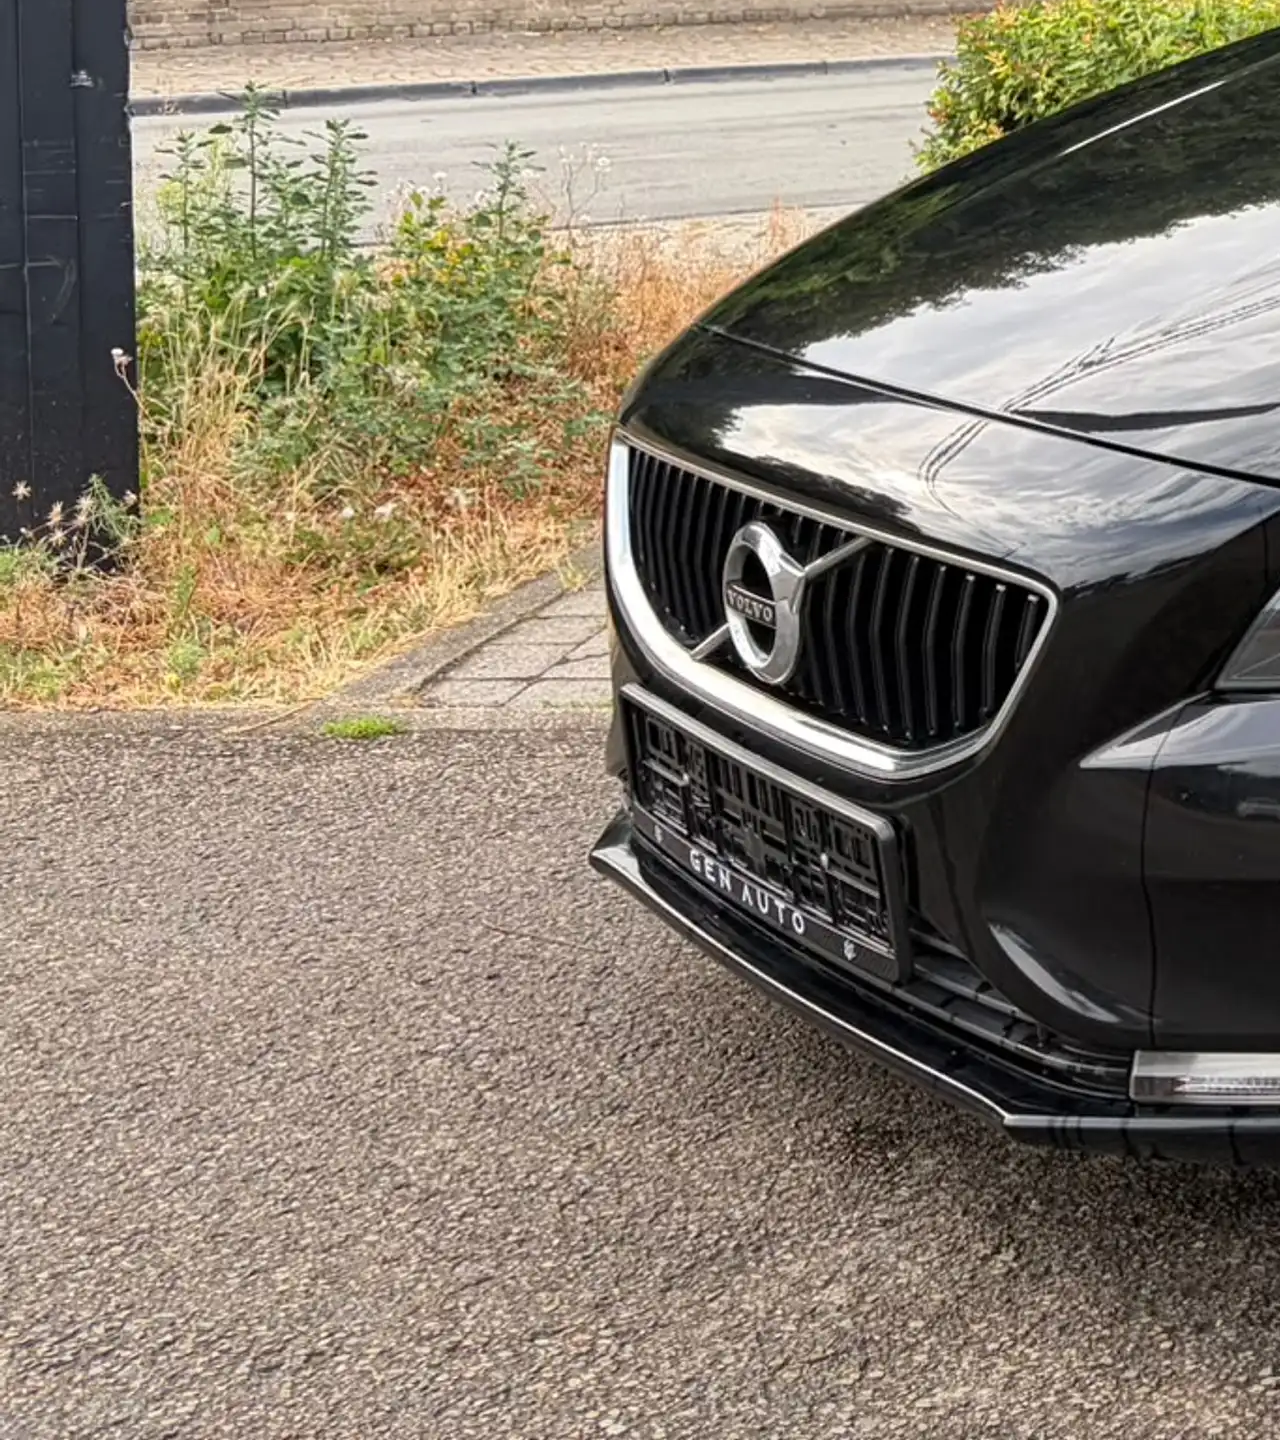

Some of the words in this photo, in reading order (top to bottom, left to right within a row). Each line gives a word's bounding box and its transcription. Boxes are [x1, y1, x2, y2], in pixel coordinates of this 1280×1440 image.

[727, 589, 774, 623] VOLVO
[689, 848, 732, 893] GEN
[741, 884, 805, 935] AUTO
